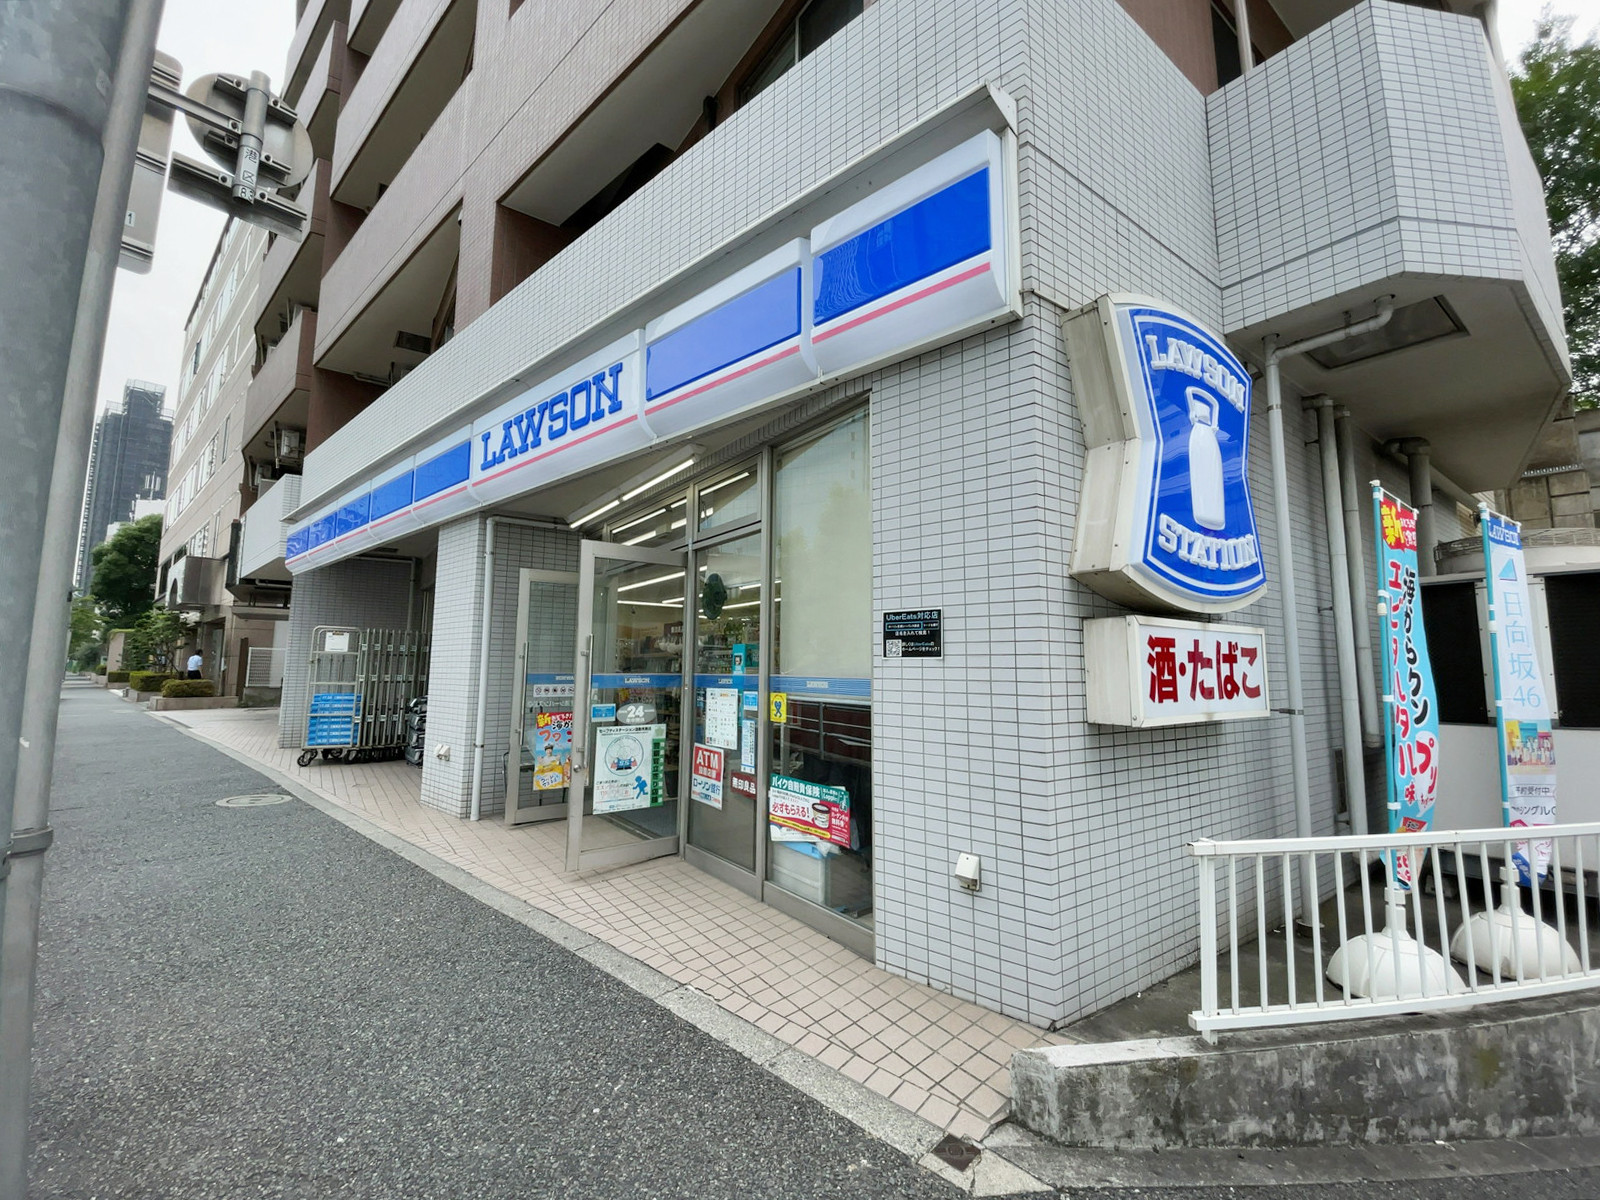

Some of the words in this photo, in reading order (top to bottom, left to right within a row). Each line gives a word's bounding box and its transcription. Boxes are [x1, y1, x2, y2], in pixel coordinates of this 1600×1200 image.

[244, 148, 257, 185] 港区
[1145, 335, 1247, 414] LAWSON
[480, 362, 624, 471] LAWSON
[1158, 512, 1259, 571] STATION
[1381, 505, 1404, 546] 新
[1488, 523, 1521, 547] LAWSON
[886, 611, 939, 621] UberEats対応店
[1502, 590, 1542, 709] 日向坂46
[1147, 634, 1262, 703] 酒・たばこ
[537, 713, 552, 729] 新
[627, 705, 645, 718] 24
[696, 750, 719, 770] ATM
[732, 777, 756, 795] 無印良品
